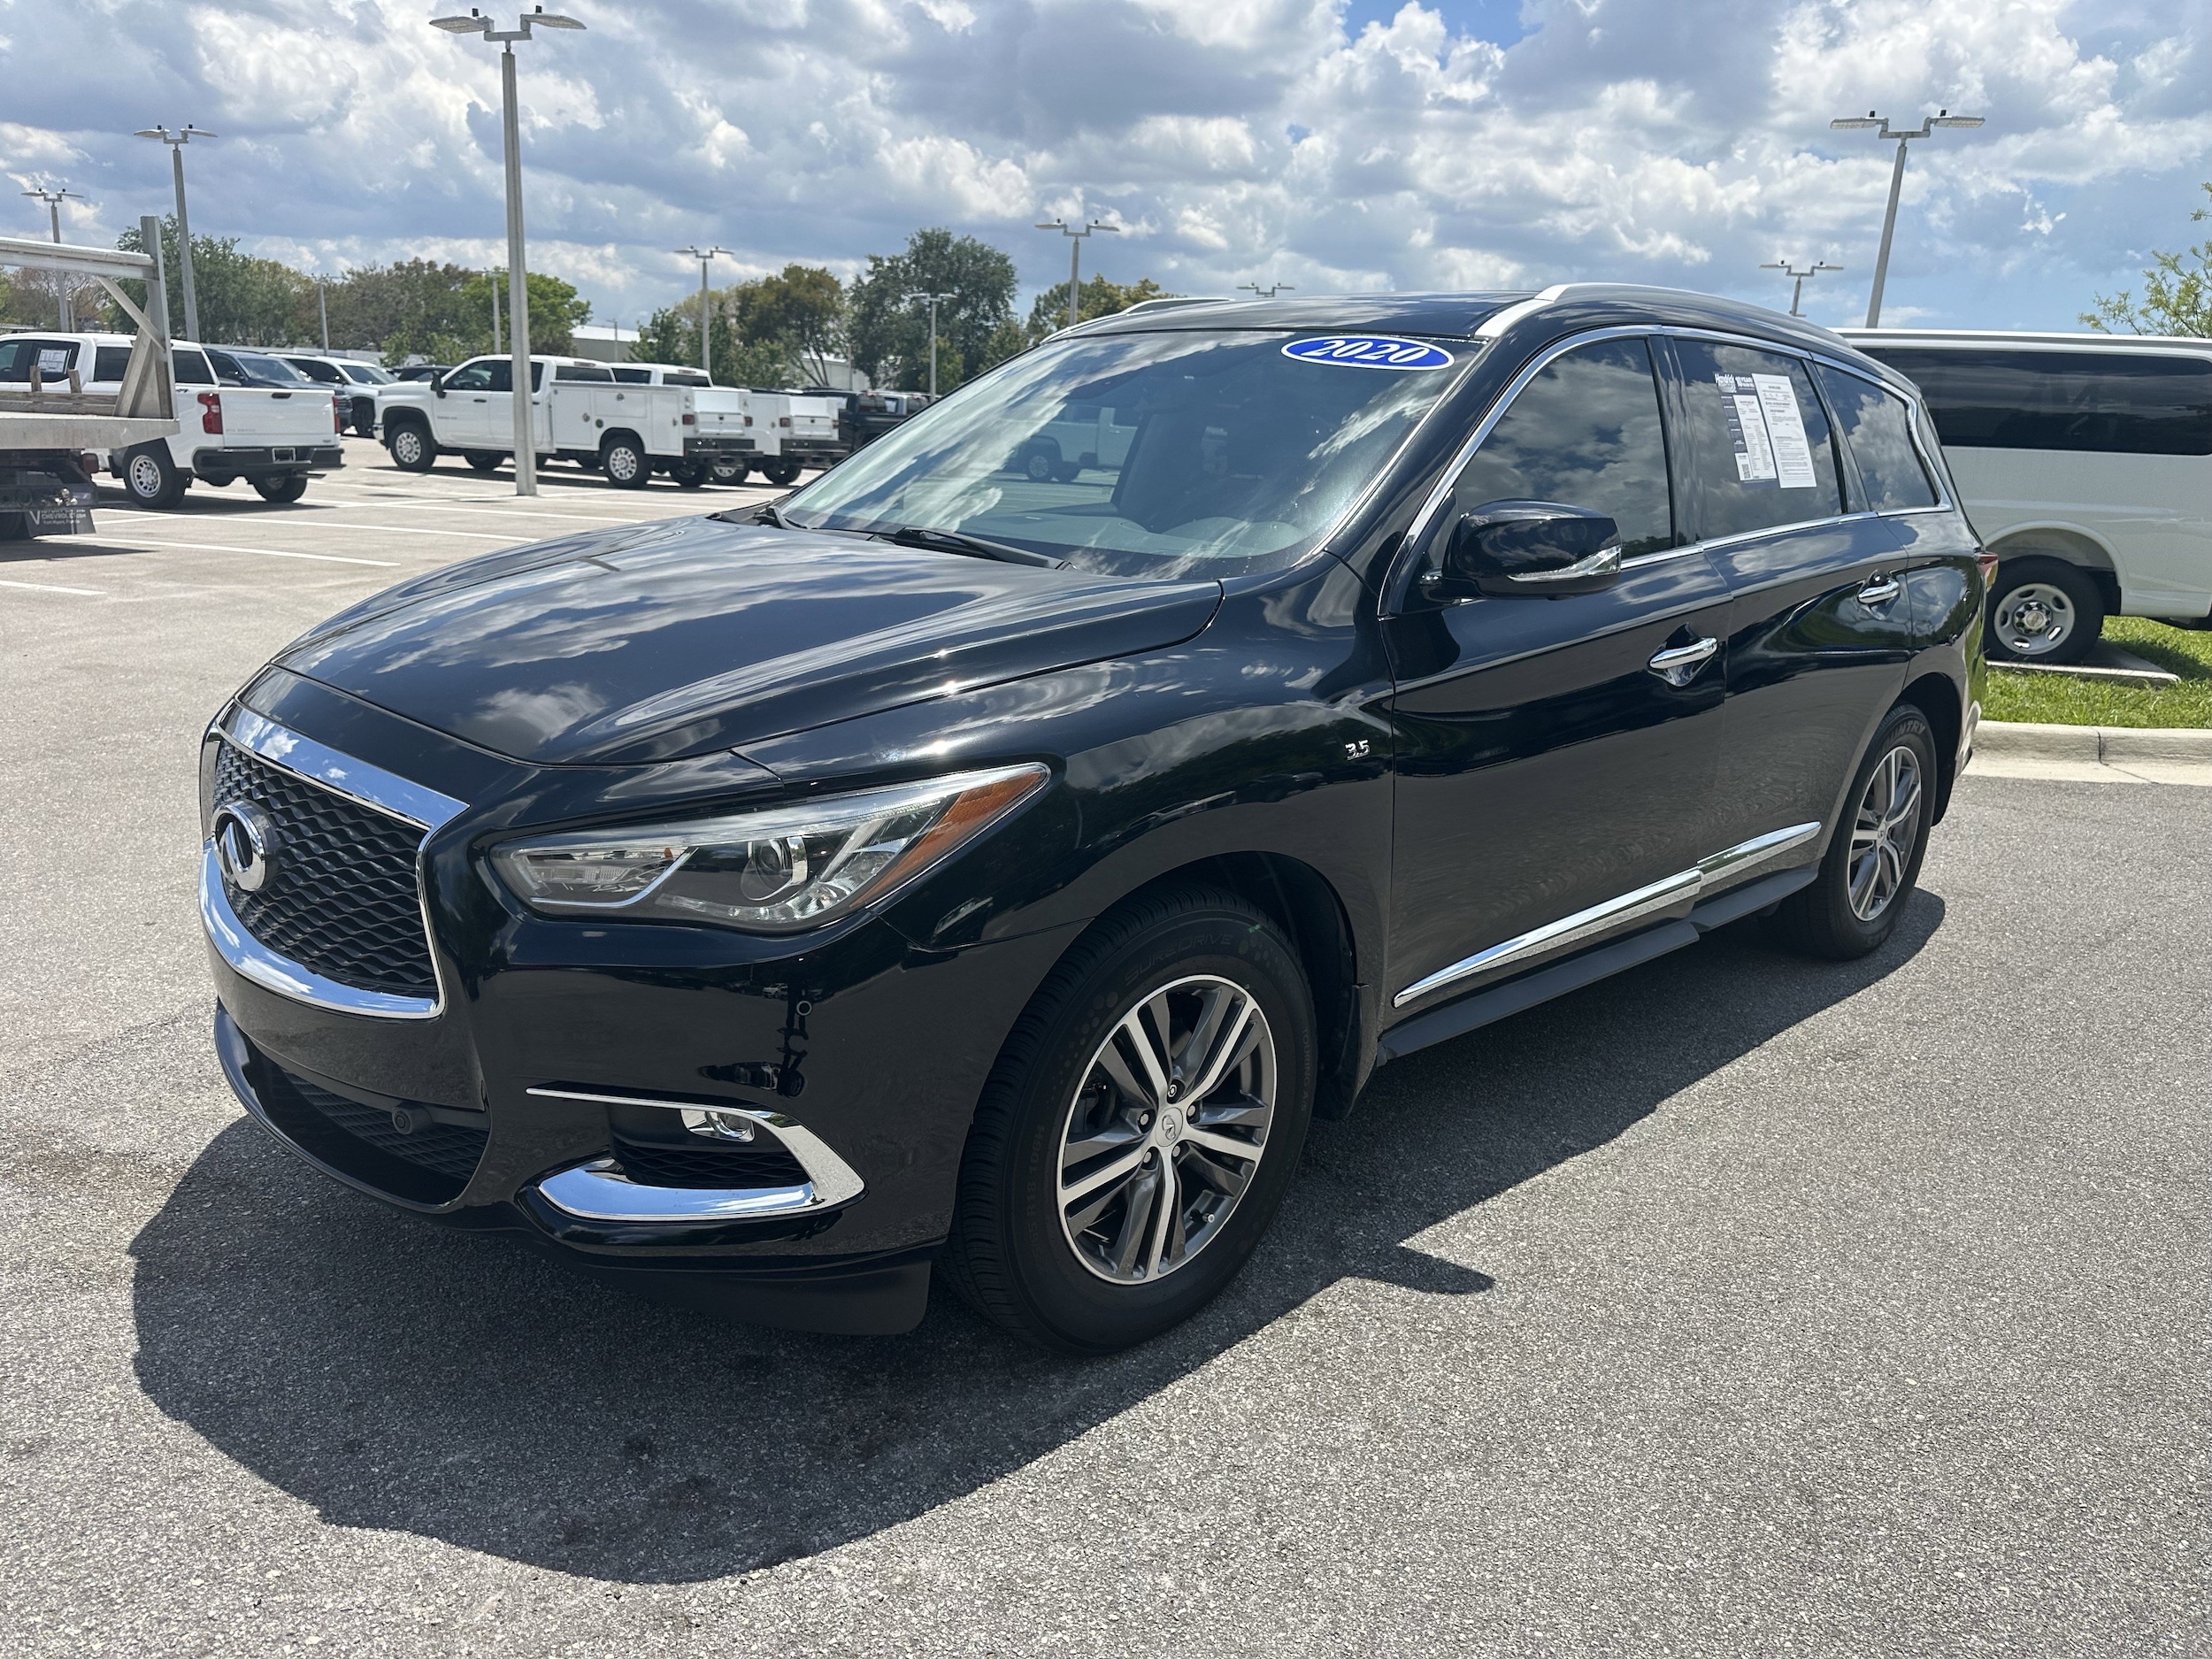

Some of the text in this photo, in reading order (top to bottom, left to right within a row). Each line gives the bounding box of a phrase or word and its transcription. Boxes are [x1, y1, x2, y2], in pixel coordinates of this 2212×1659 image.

[1300, 339, 1431, 364] 2020
[1125, 933, 1233, 987] SUREDRIVE
[1302, 1026, 1310, 1087] TOURING
